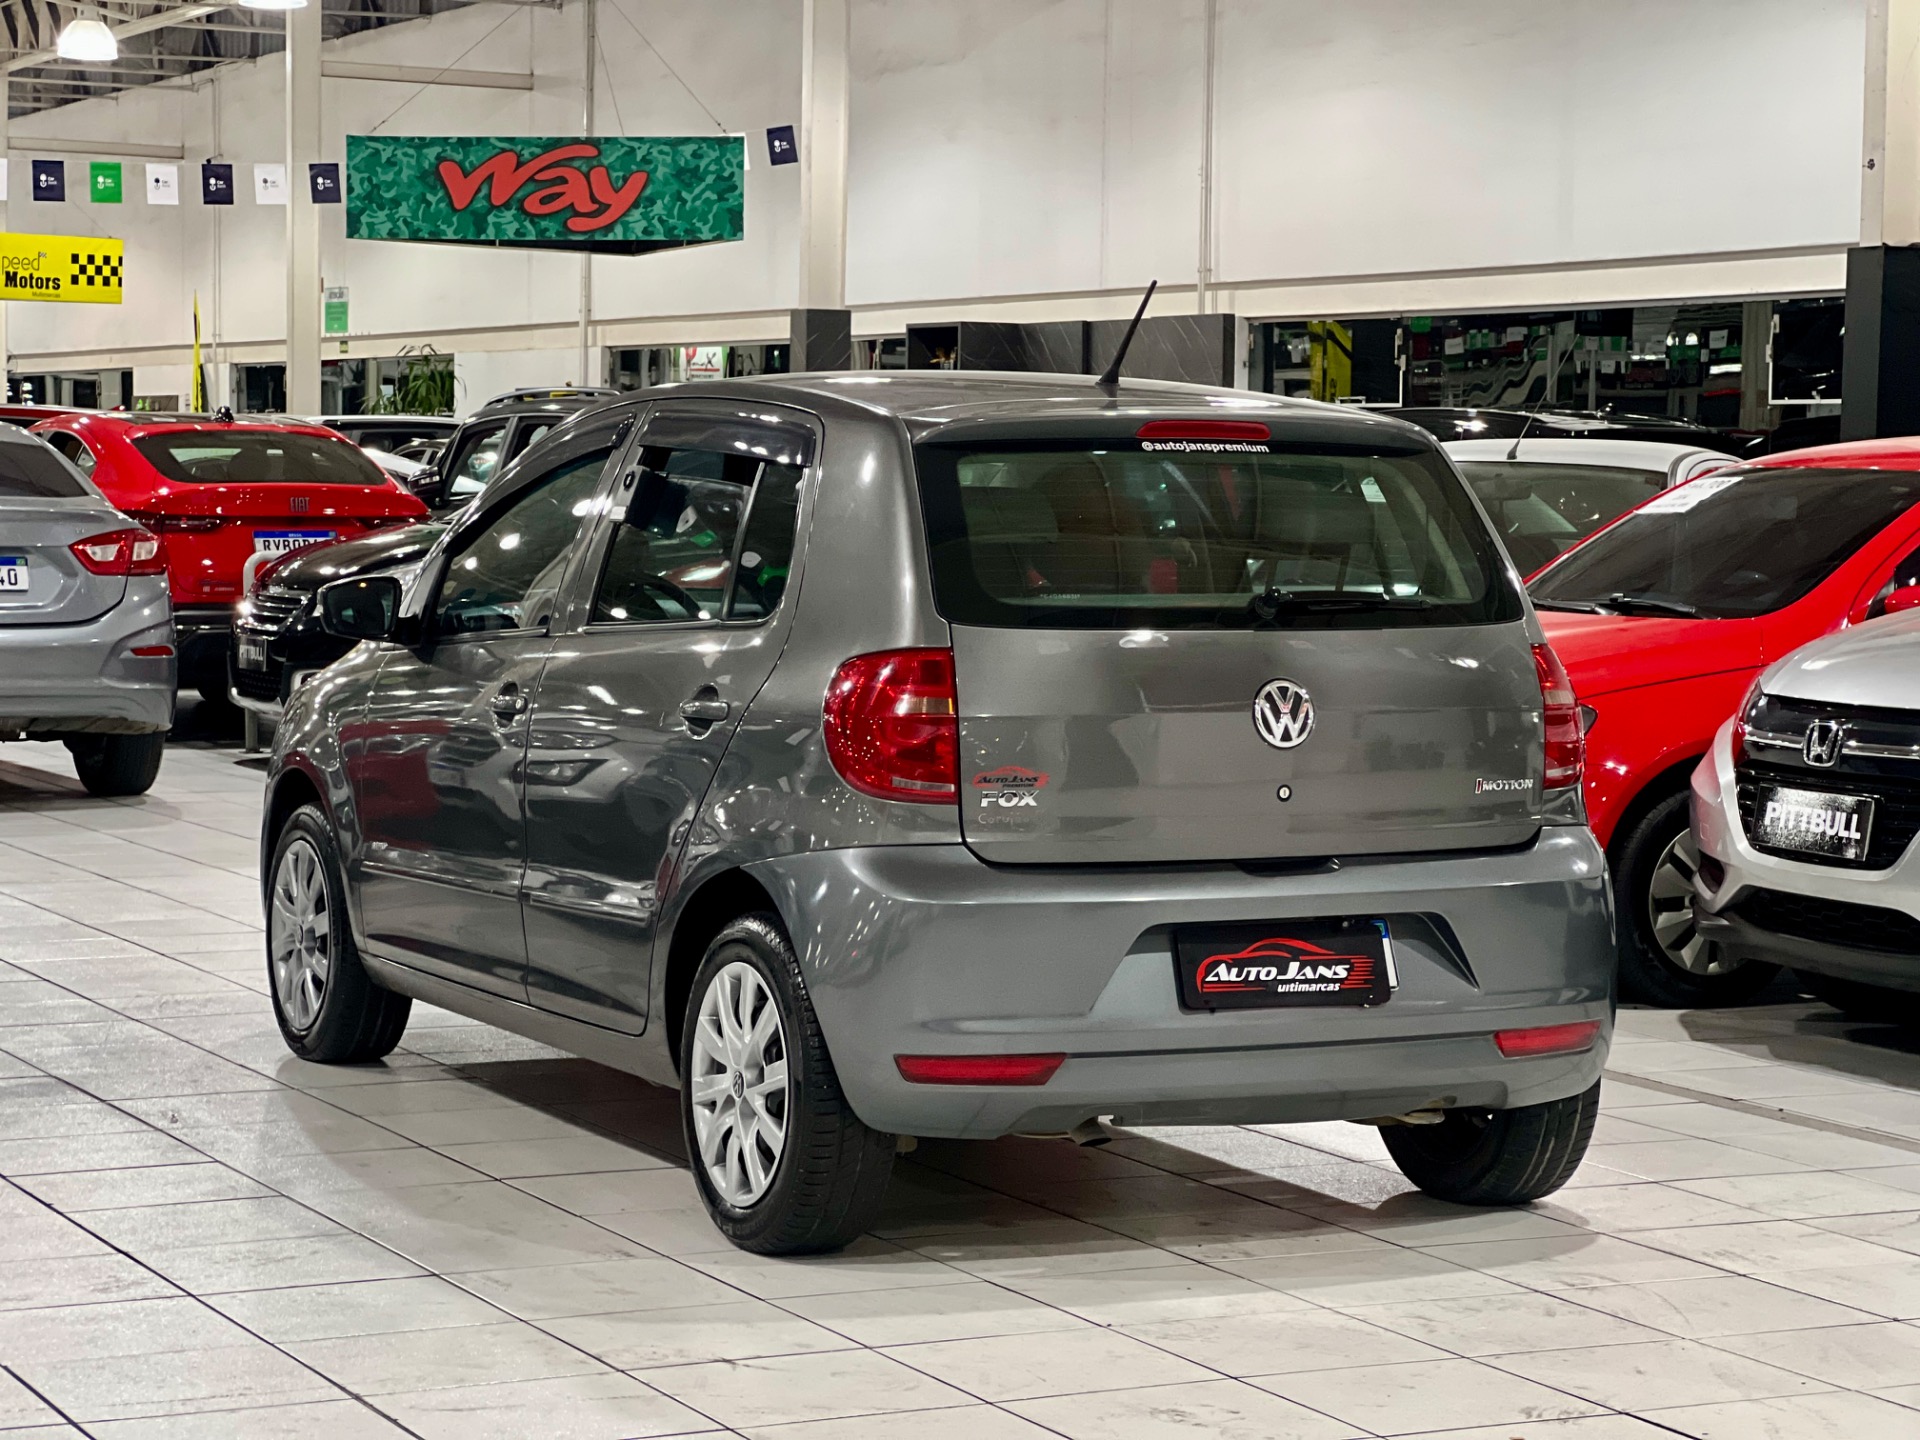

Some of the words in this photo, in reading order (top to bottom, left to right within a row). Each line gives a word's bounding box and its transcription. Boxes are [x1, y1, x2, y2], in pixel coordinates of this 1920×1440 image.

[439, 144, 647, 231] Way
[4, 270, 61, 291] Motors
[1141, 441, 1270, 453] @autojanspremium
[290, 497, 310, 513] FIAT
[980, 790, 1040, 808] FOX
[1764, 800, 1861, 839] PITTBULL
